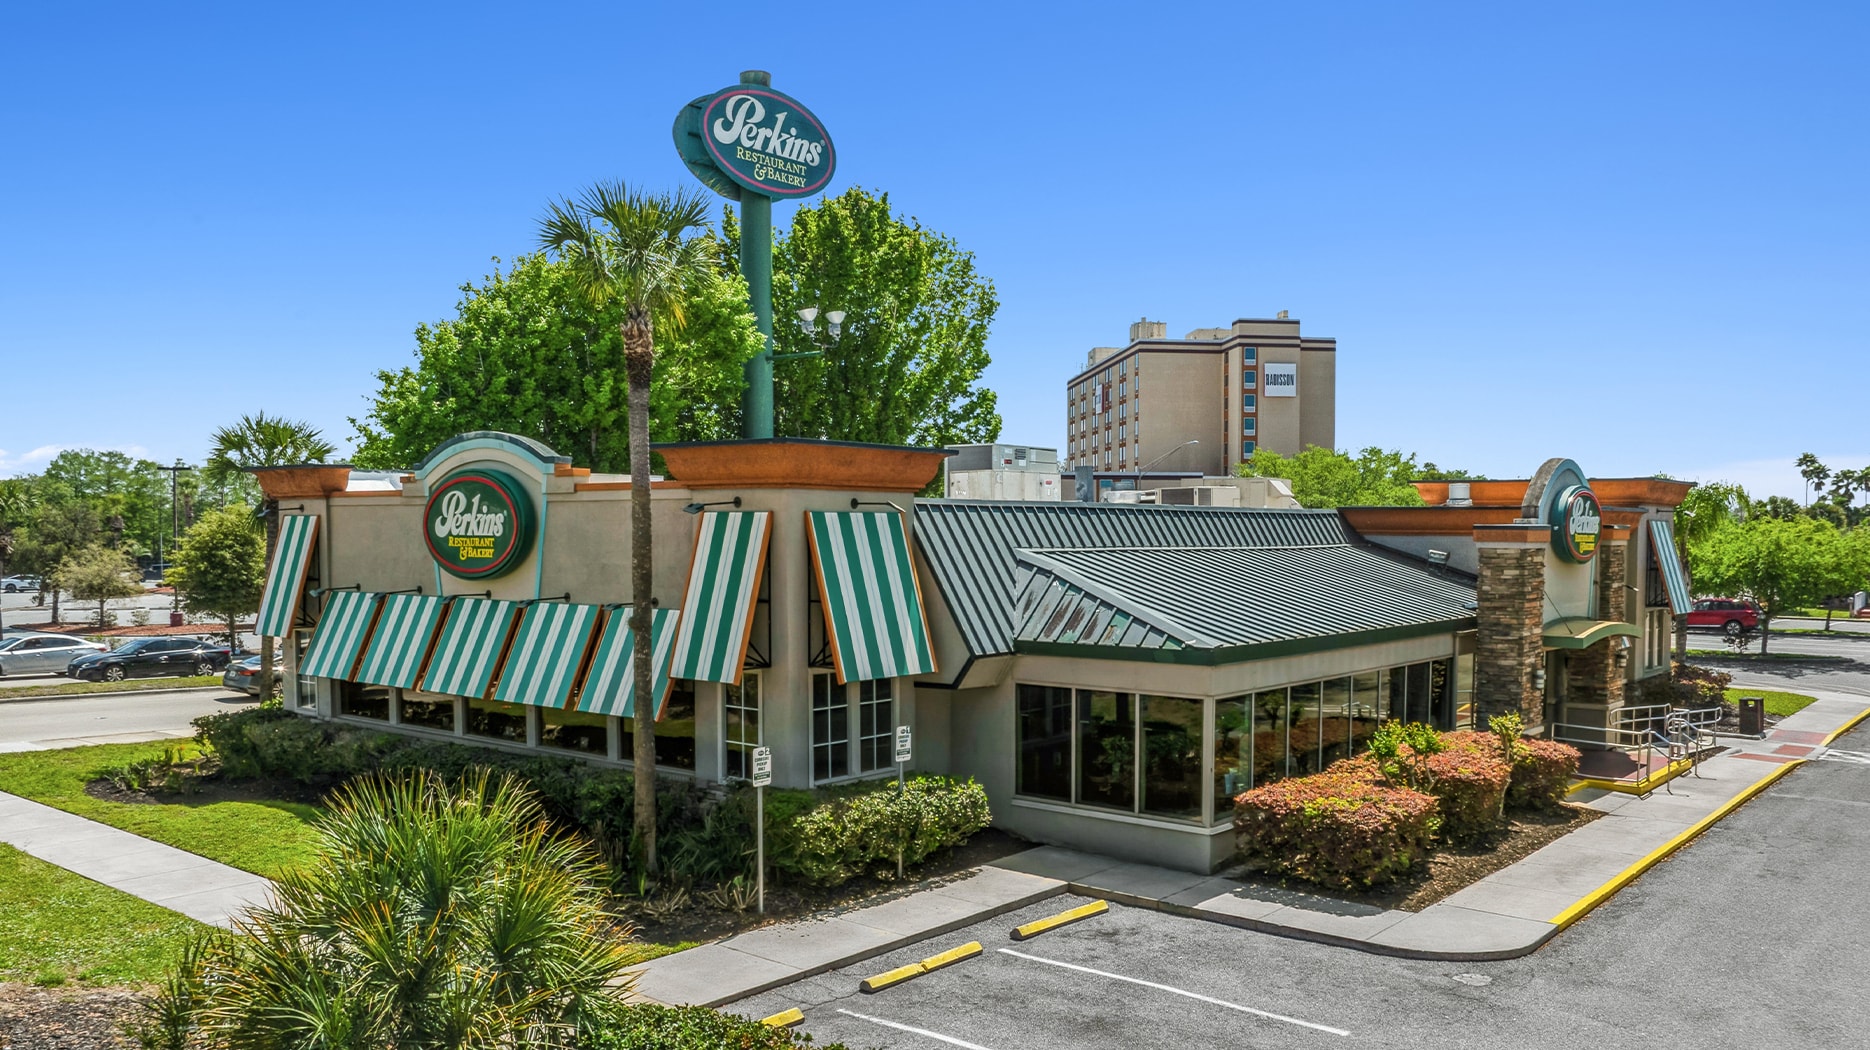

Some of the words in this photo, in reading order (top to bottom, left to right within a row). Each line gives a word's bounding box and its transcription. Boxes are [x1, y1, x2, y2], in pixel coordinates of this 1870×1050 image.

[713, 94, 822, 167] Perkins
[754, 163, 767, 181] &
[767, 167, 807, 188] BAKERY
[1265, 373, 1295, 386] RADISSON
[434, 490, 505, 538] Perkins
[1569, 496, 1600, 535] Perkins
[448, 536, 495, 547] RESTAURANT
[460, 547, 468, 560] &
[468, 547, 495, 558] BAKERY
